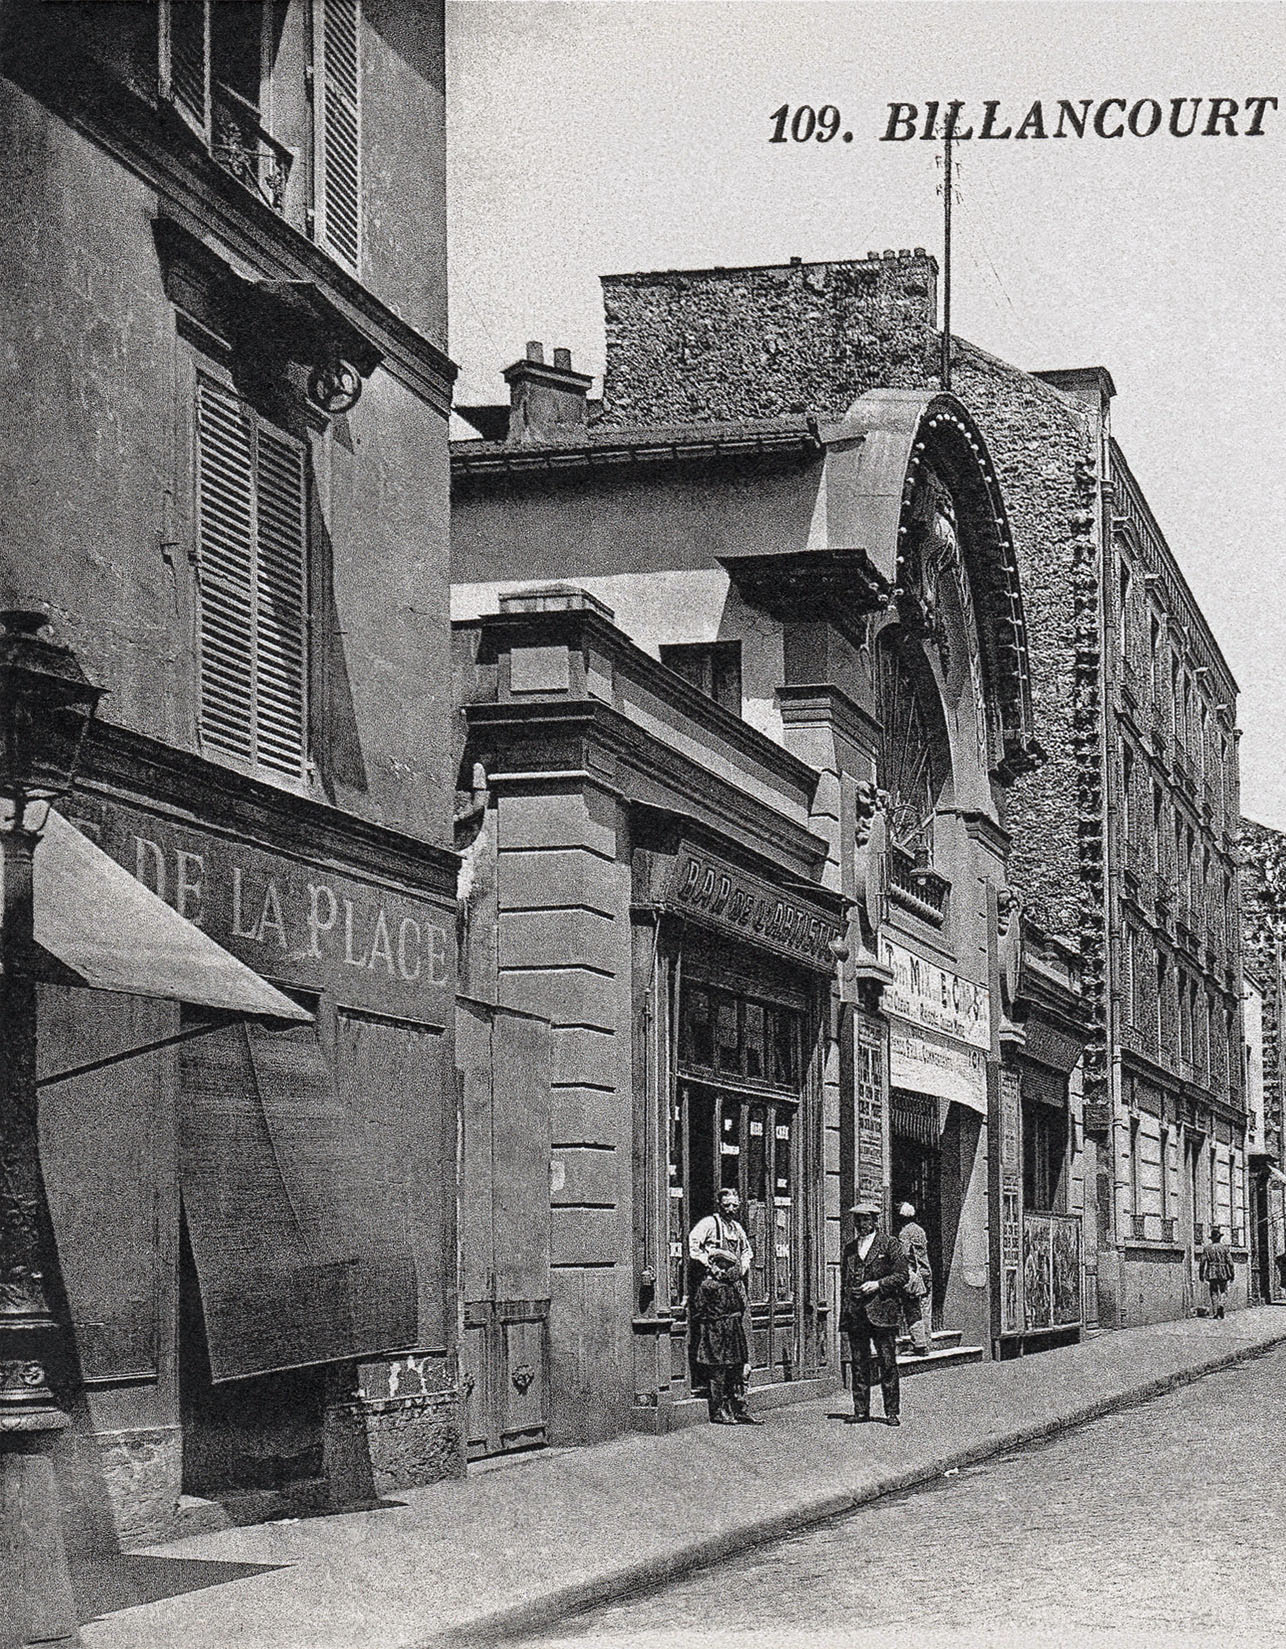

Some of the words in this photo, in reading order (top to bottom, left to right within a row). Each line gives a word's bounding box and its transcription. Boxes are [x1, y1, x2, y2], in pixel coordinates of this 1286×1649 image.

[232, 867, 288, 948] LA
[307, 884, 447, 985] PLACE
[679, 858, 732, 916] BAR
